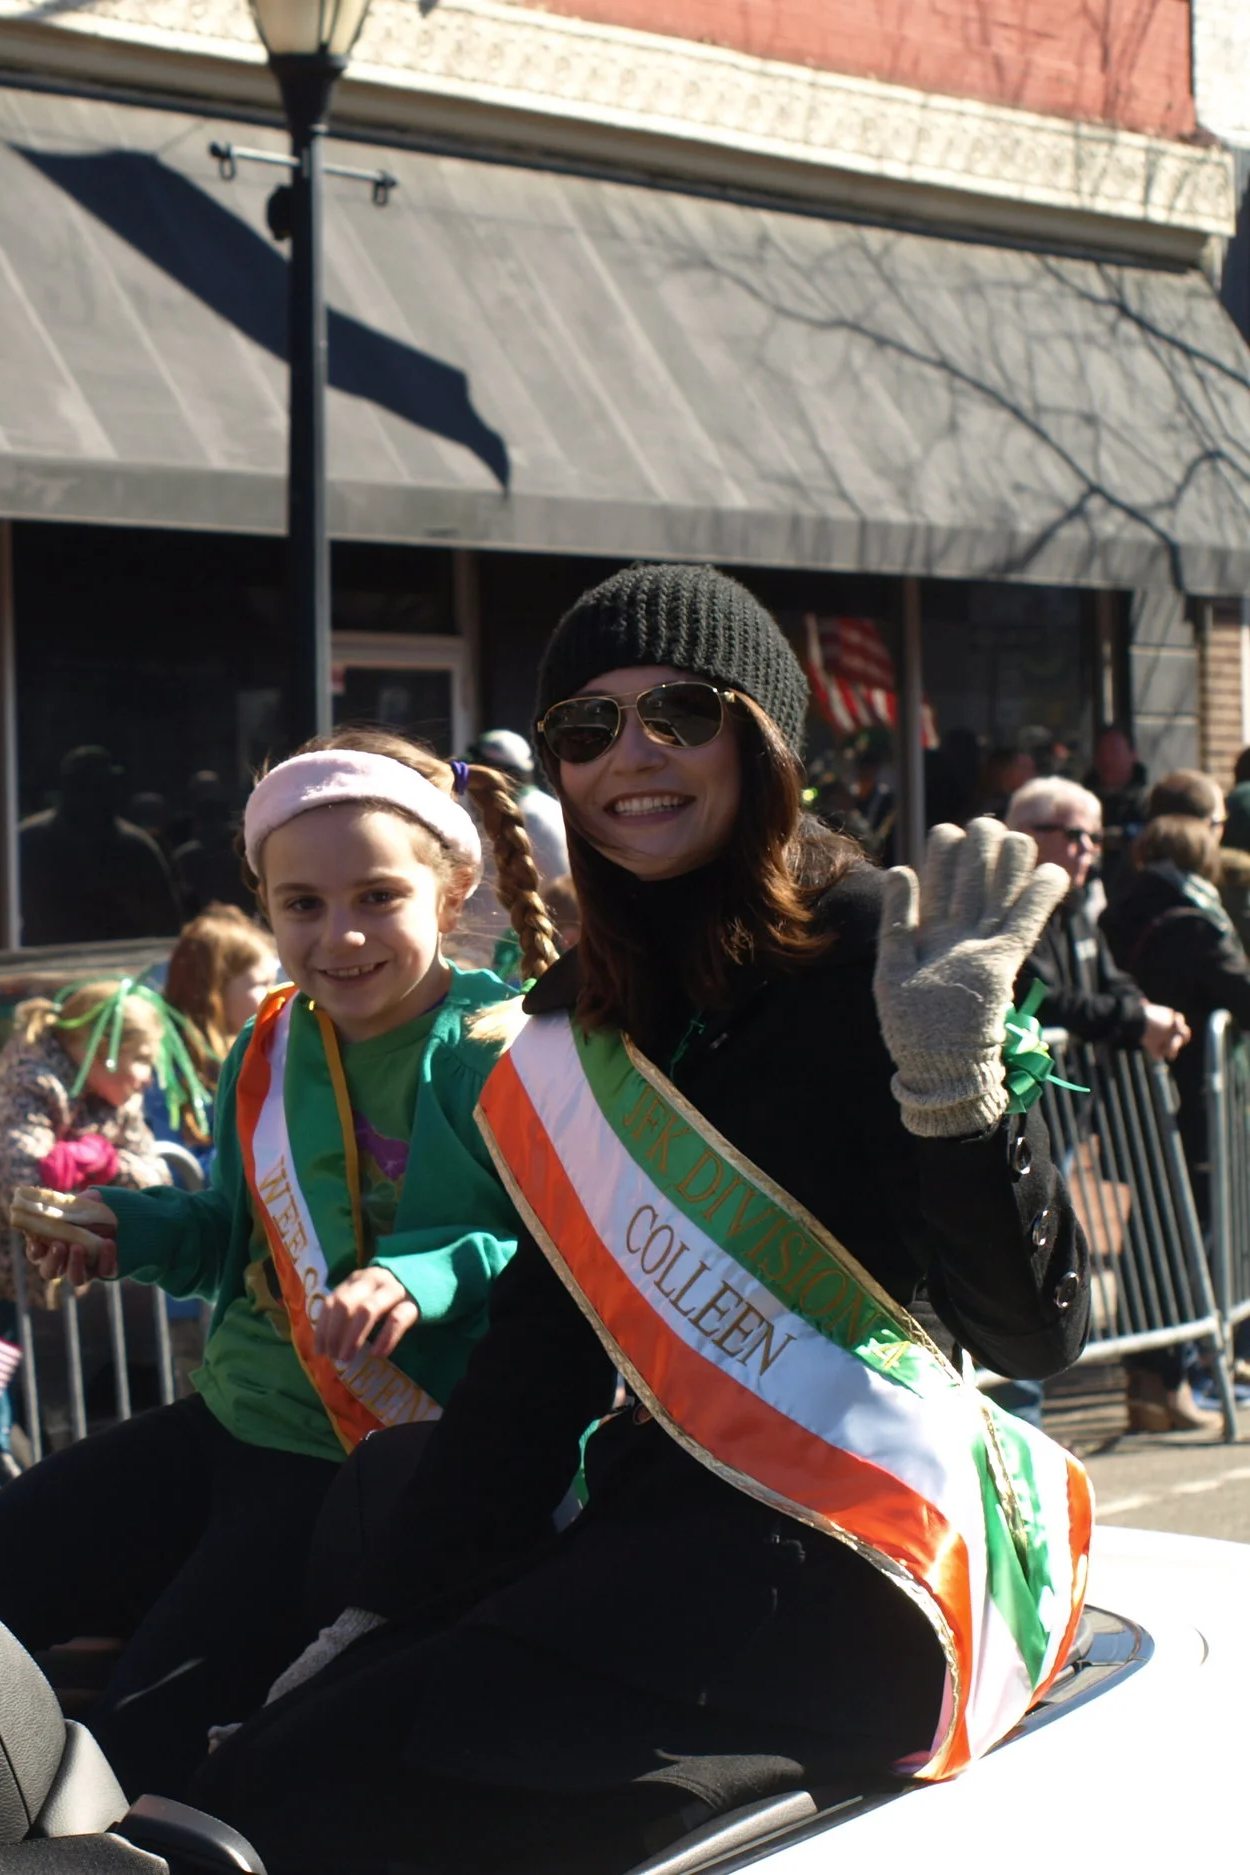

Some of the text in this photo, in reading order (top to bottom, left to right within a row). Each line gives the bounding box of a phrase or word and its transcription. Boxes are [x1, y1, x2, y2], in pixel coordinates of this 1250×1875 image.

[258, 1154, 439, 1427] WEE COEEN
[623, 1083, 691, 1174] JFK
[674, 1147, 883, 1350] DIVISION
[626, 1204, 797, 1376] COLLEEN
